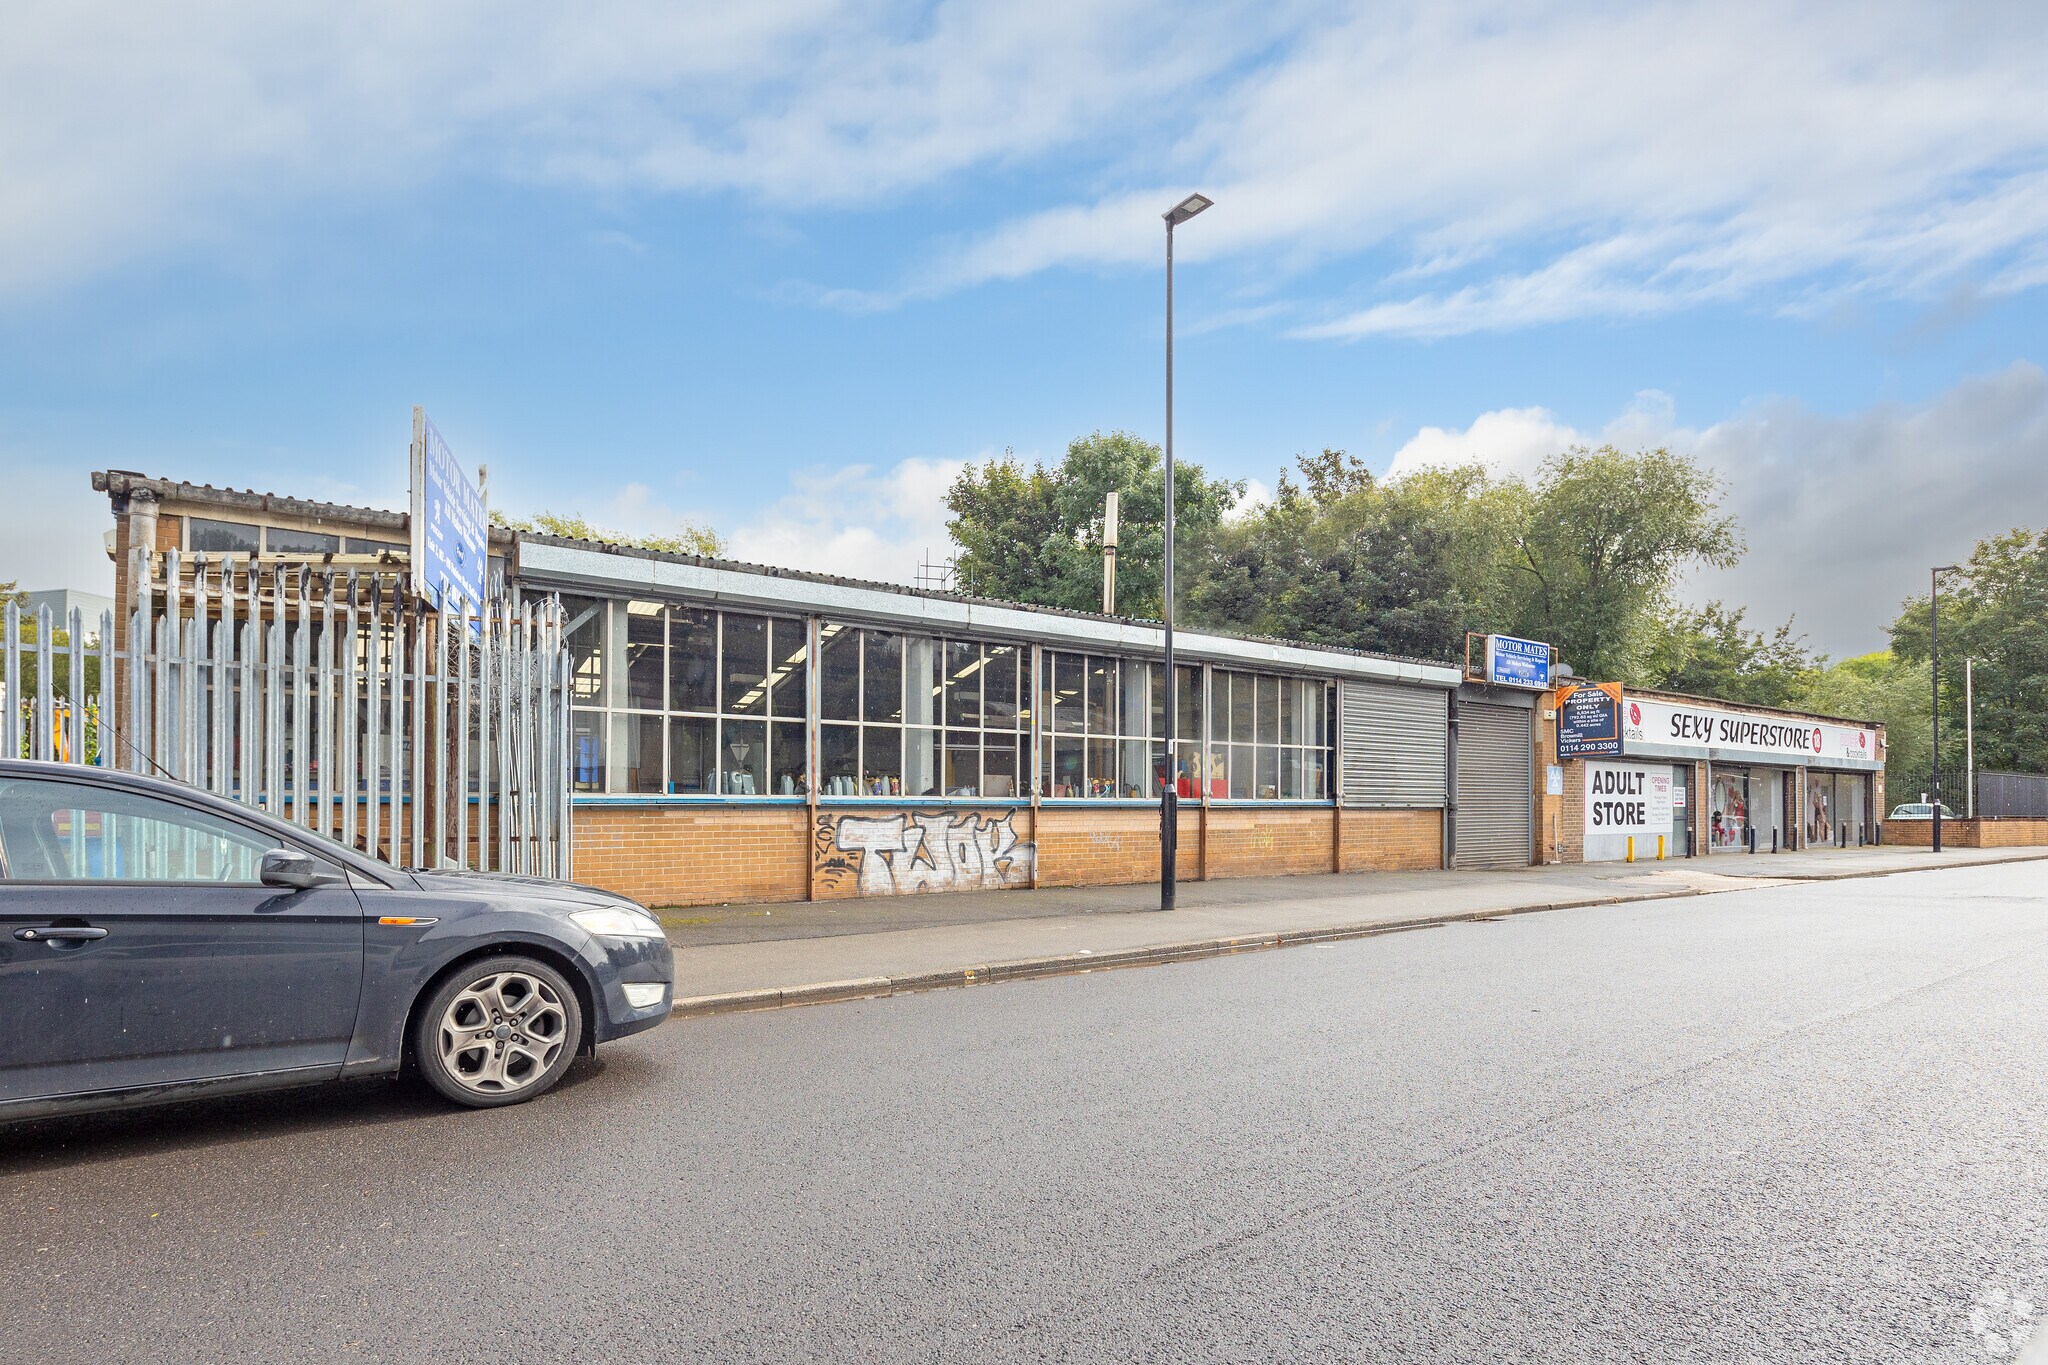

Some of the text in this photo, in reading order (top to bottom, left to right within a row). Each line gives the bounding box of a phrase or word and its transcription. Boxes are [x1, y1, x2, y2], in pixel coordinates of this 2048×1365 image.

[429, 428, 461, 497] MOTOR
[463, 478, 487, 535] MATES
[1496, 639, 1548, 656] MOTOR MATES
[1509, 676, 1522, 684] 0114
[1565, 696, 1611, 705] PROPERTY
[1670, 713, 1714, 743] SEXY
[1719, 719, 1811, 750] SUPERSTORE
[1560, 742, 1618, 752] 0114 290 3300
[1592, 770, 1645, 795] ADULT
[1651, 776, 1670, 784] OPENING
[1655, 784, 1667, 792] TIMES
[1592, 801, 1646, 826] STORE
